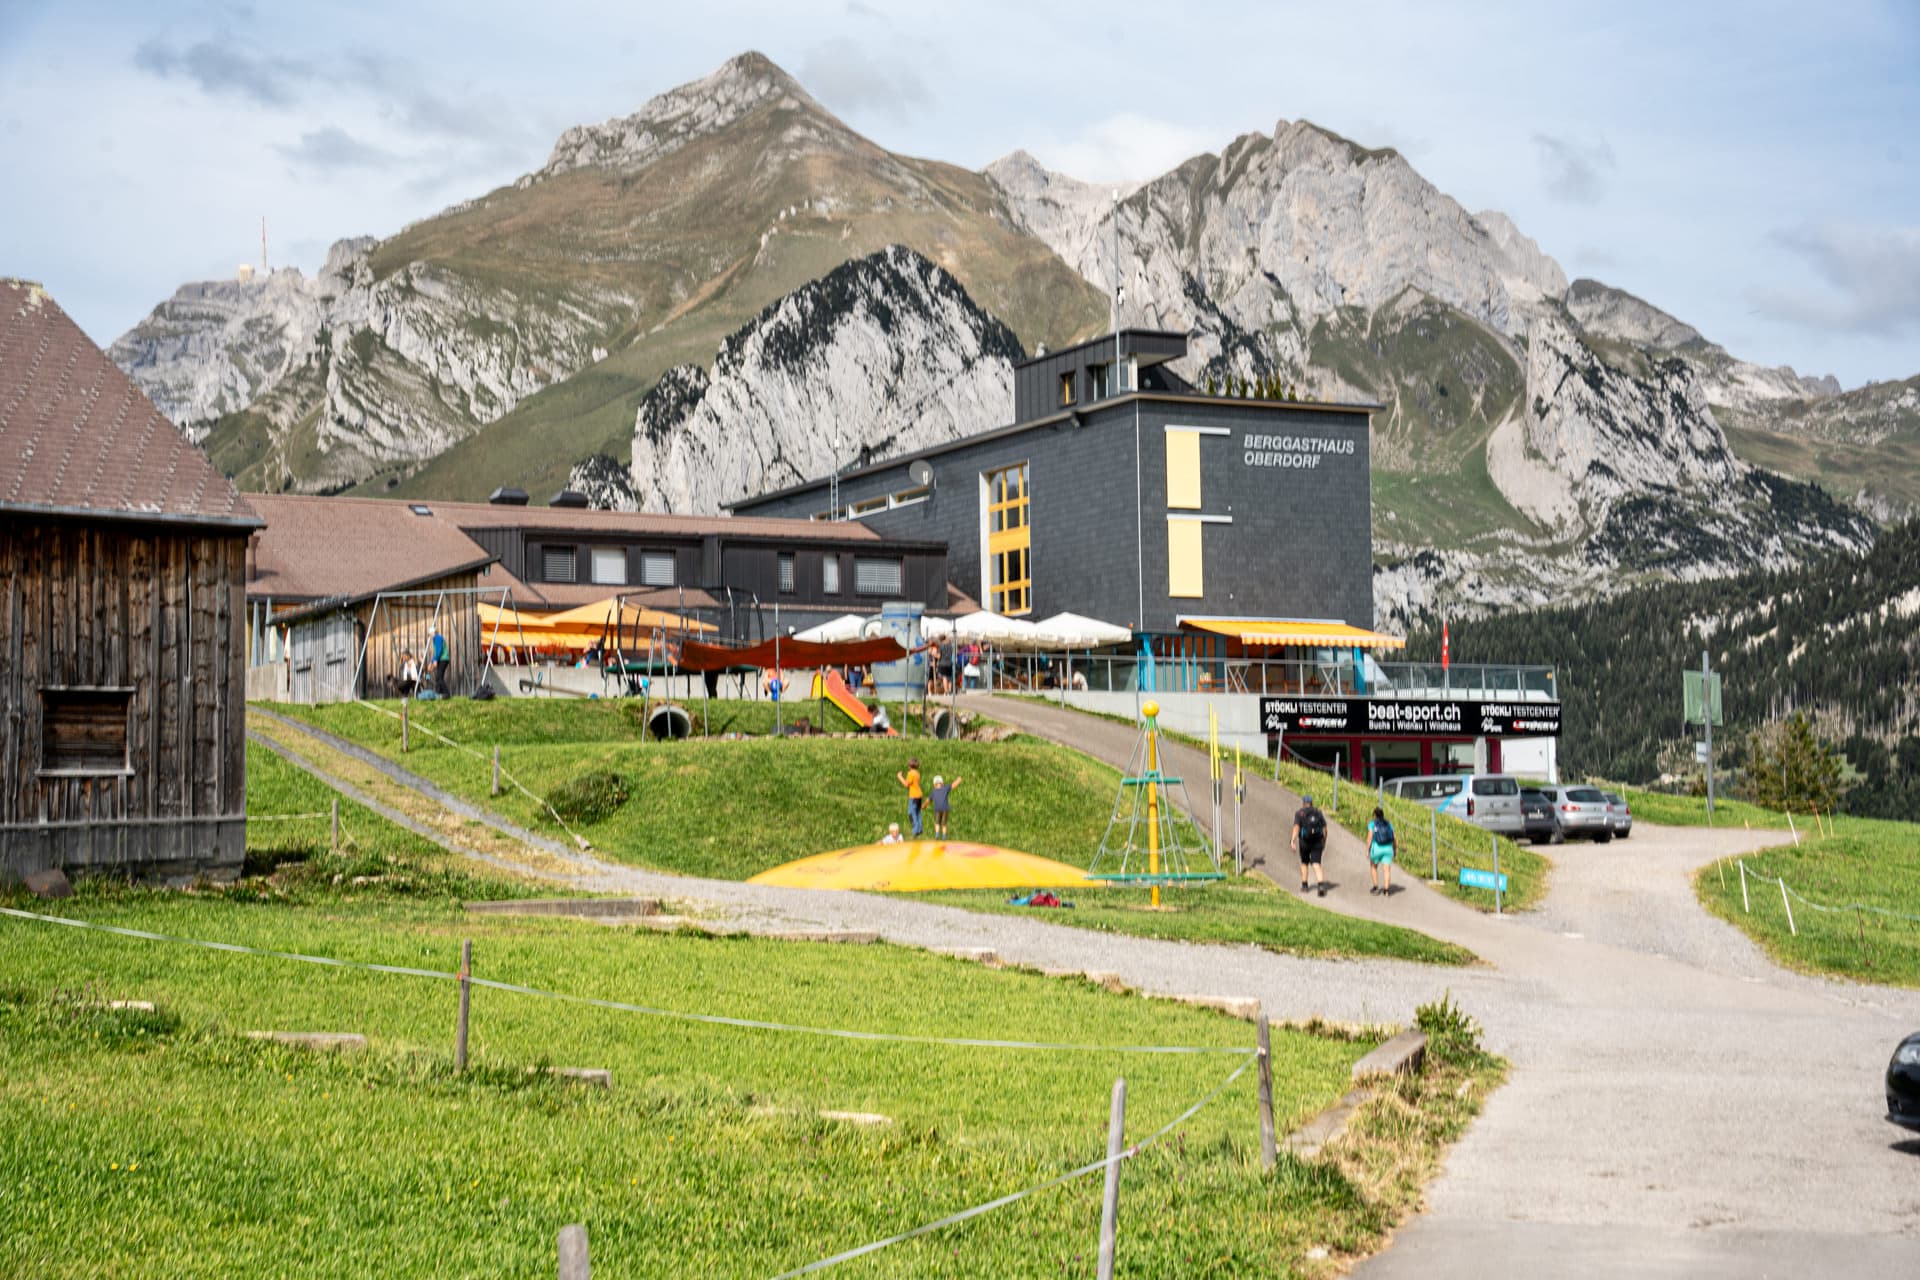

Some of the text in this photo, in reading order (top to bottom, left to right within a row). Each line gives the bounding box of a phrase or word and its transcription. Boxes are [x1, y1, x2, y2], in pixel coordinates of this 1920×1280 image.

[1244, 434, 1355, 455] BERGGASTHAUS
[1244, 451, 1321, 469] OBERDORF
[1265, 700, 1347, 714] STÖCKLI TESTCENTER
[1481, 704, 1560, 717] STÖCKLI TESTCENTER
